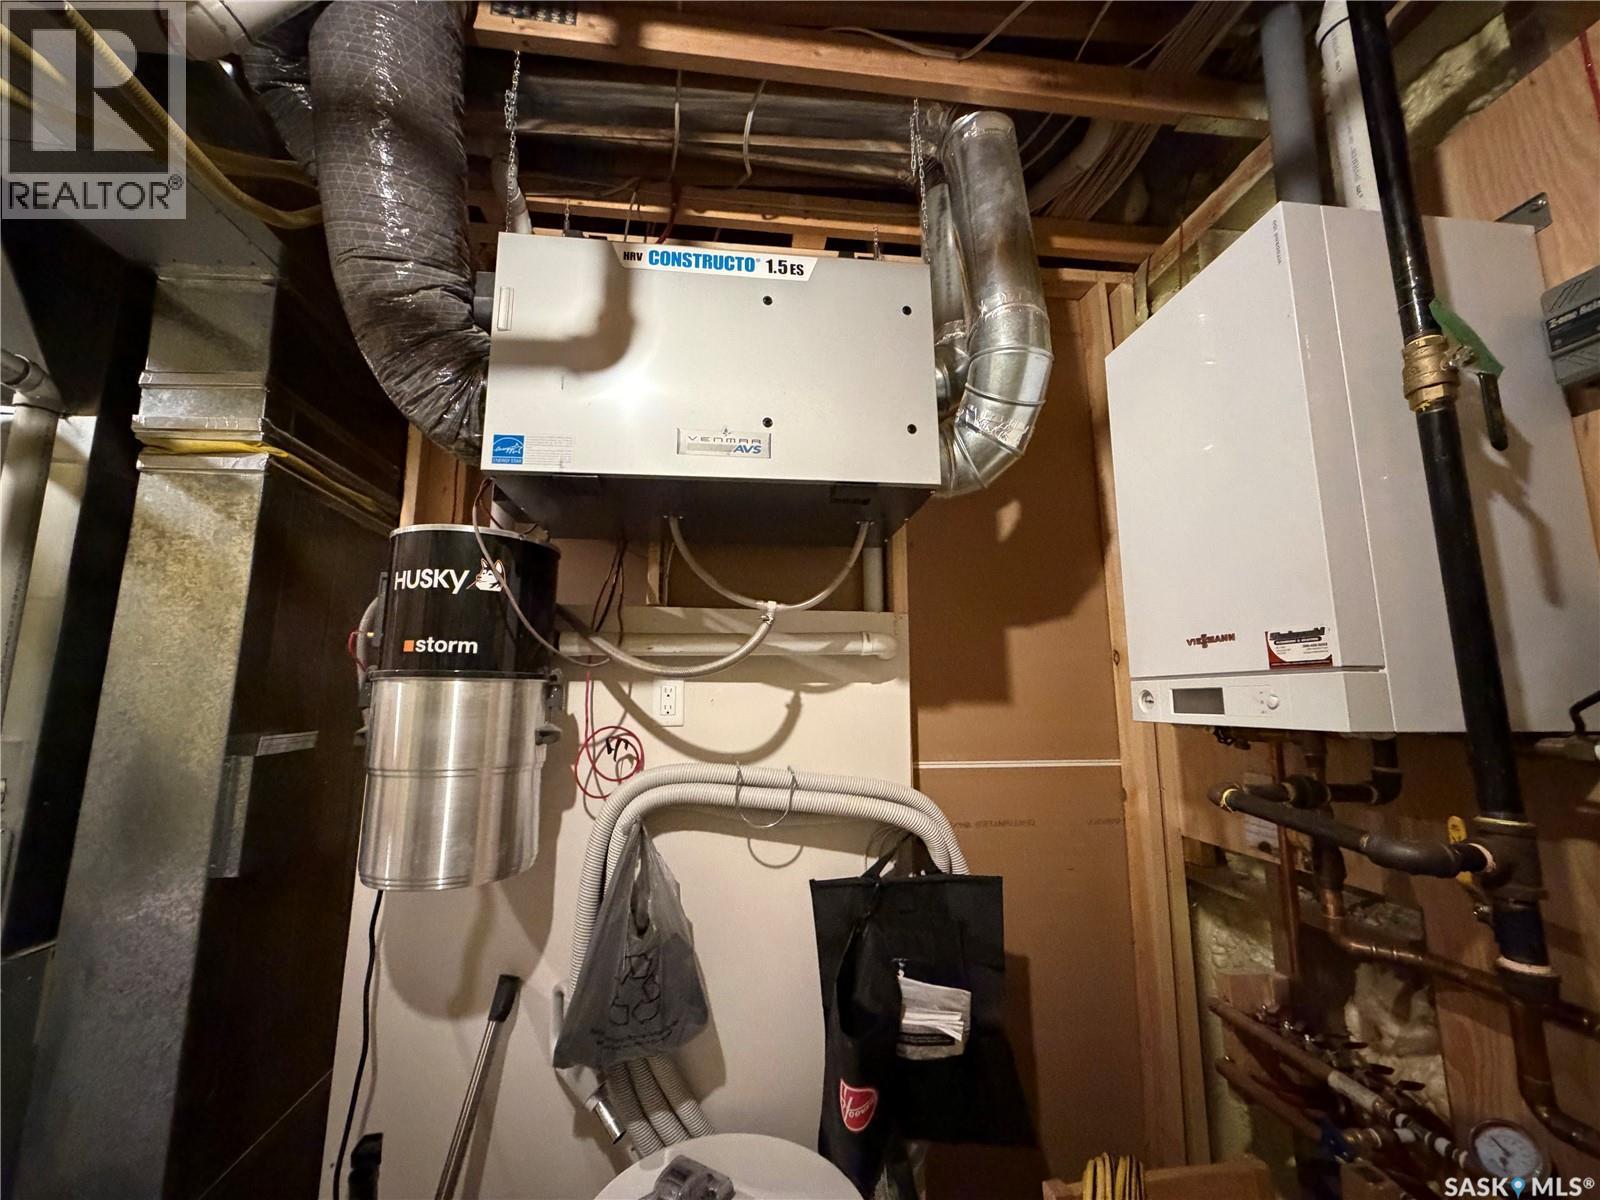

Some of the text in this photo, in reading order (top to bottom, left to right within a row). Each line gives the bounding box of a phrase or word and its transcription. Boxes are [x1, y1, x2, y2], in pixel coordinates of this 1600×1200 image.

[623, 251, 643, 262] HRV
[733, 445, 762, 454] AVS
[415, 637, 478, 654] storm
